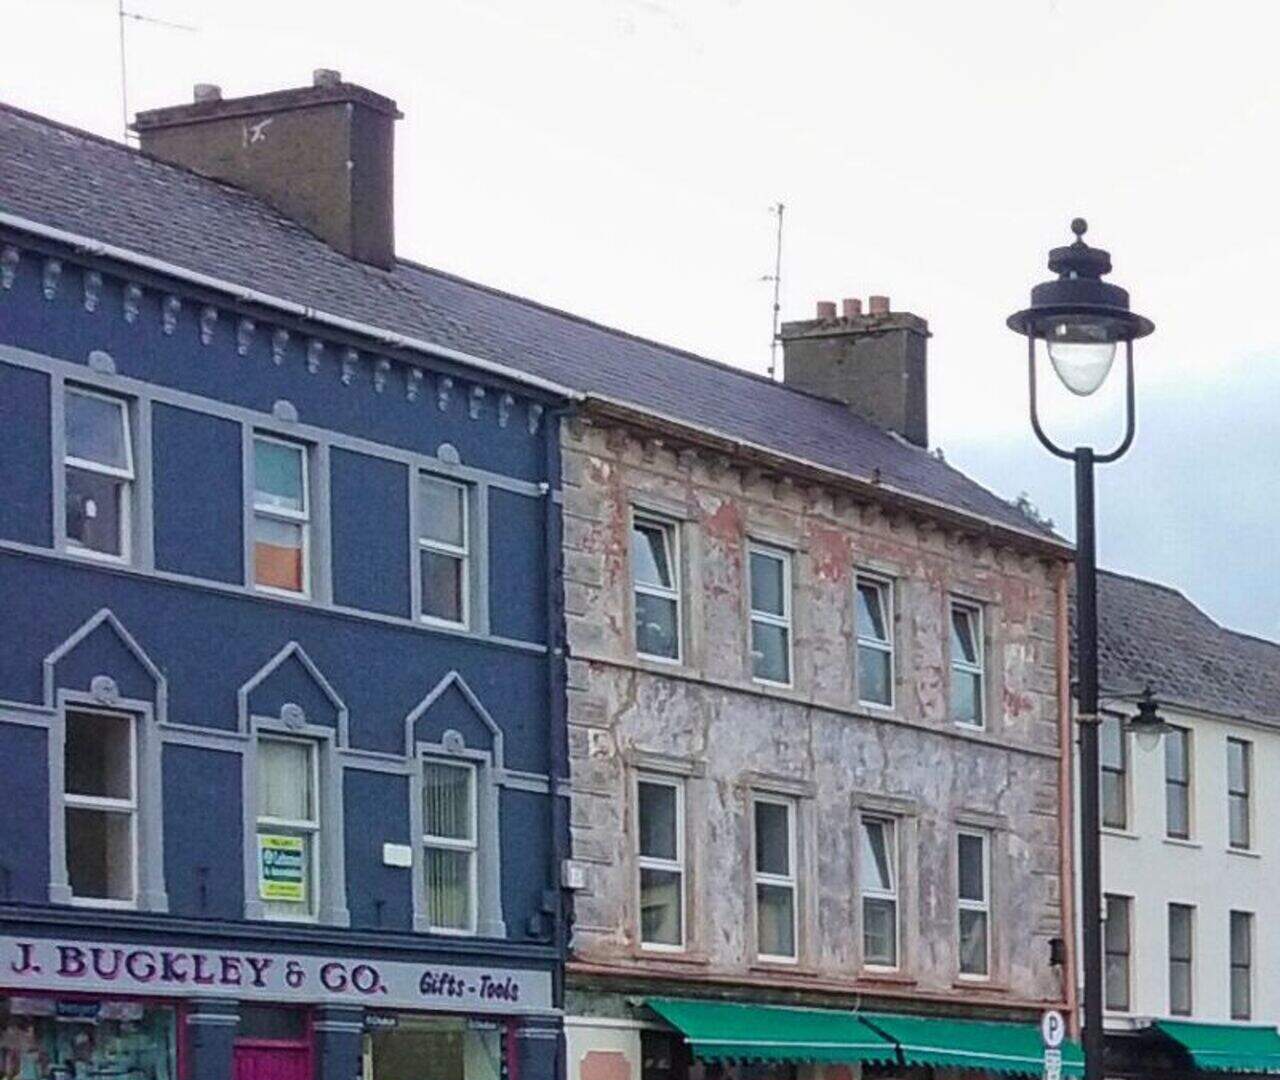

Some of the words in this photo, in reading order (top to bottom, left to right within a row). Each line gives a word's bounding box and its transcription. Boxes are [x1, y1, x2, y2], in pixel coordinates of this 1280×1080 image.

[11, 943, 41, 973] J.
[56, 945, 273, 987] BUCKLEY
[285, 961, 305, 988] &
[419, 971, 465, 998] Gifts
[478, 975, 519, 1002] Tools
[1048, 1015, 1058, 1040] P
